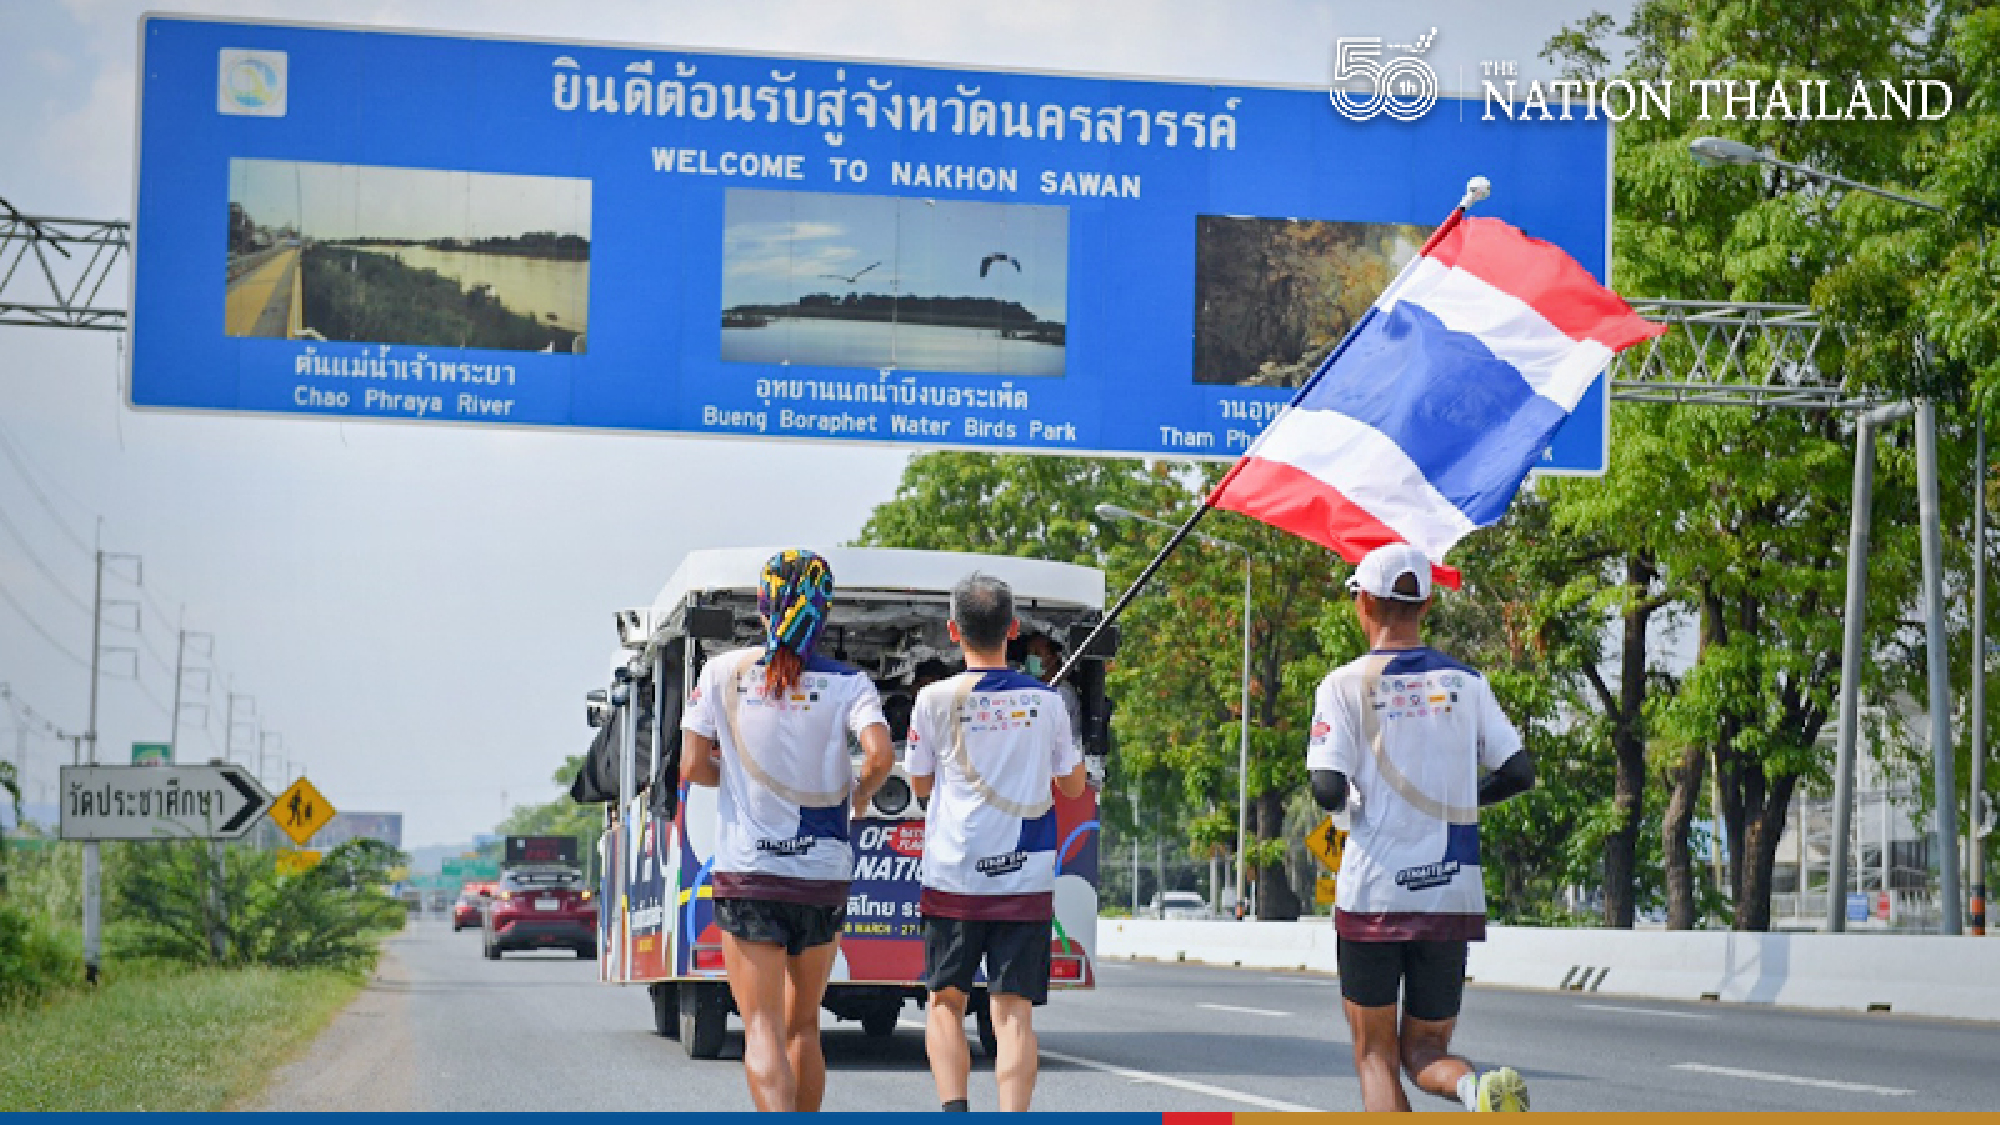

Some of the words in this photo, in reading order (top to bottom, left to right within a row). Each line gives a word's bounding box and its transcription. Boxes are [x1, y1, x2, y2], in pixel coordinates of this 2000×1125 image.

[552, 56, 1242, 150] ยินดีต้อนรับสู่จังหวัดนครสวรรค์
[651, 146, 806, 180] WELCOME
[829, 157, 869, 183] TO
[890, 160, 1019, 193] NAKHON
[1039, 170, 1142, 199] SAWAN
[294, 344, 516, 386] ต้นแม่น้ำเจ้าพระยา
[293, 384, 350, 409] Chao
[363, 389, 444, 418] Phraya
[456, 392, 516, 416] River
[702, 404, 768, 433] Bueng
[779, 409, 878, 435] Boraphet
[890, 413, 951, 437] Water
[963, 416, 1017, 439] Birds
[1028, 420, 1078, 442] Park
[1159, 425, 1216, 448] Tham
[1225, 427, 1259, 448] Ph
[858, 826, 897, 851] OF
